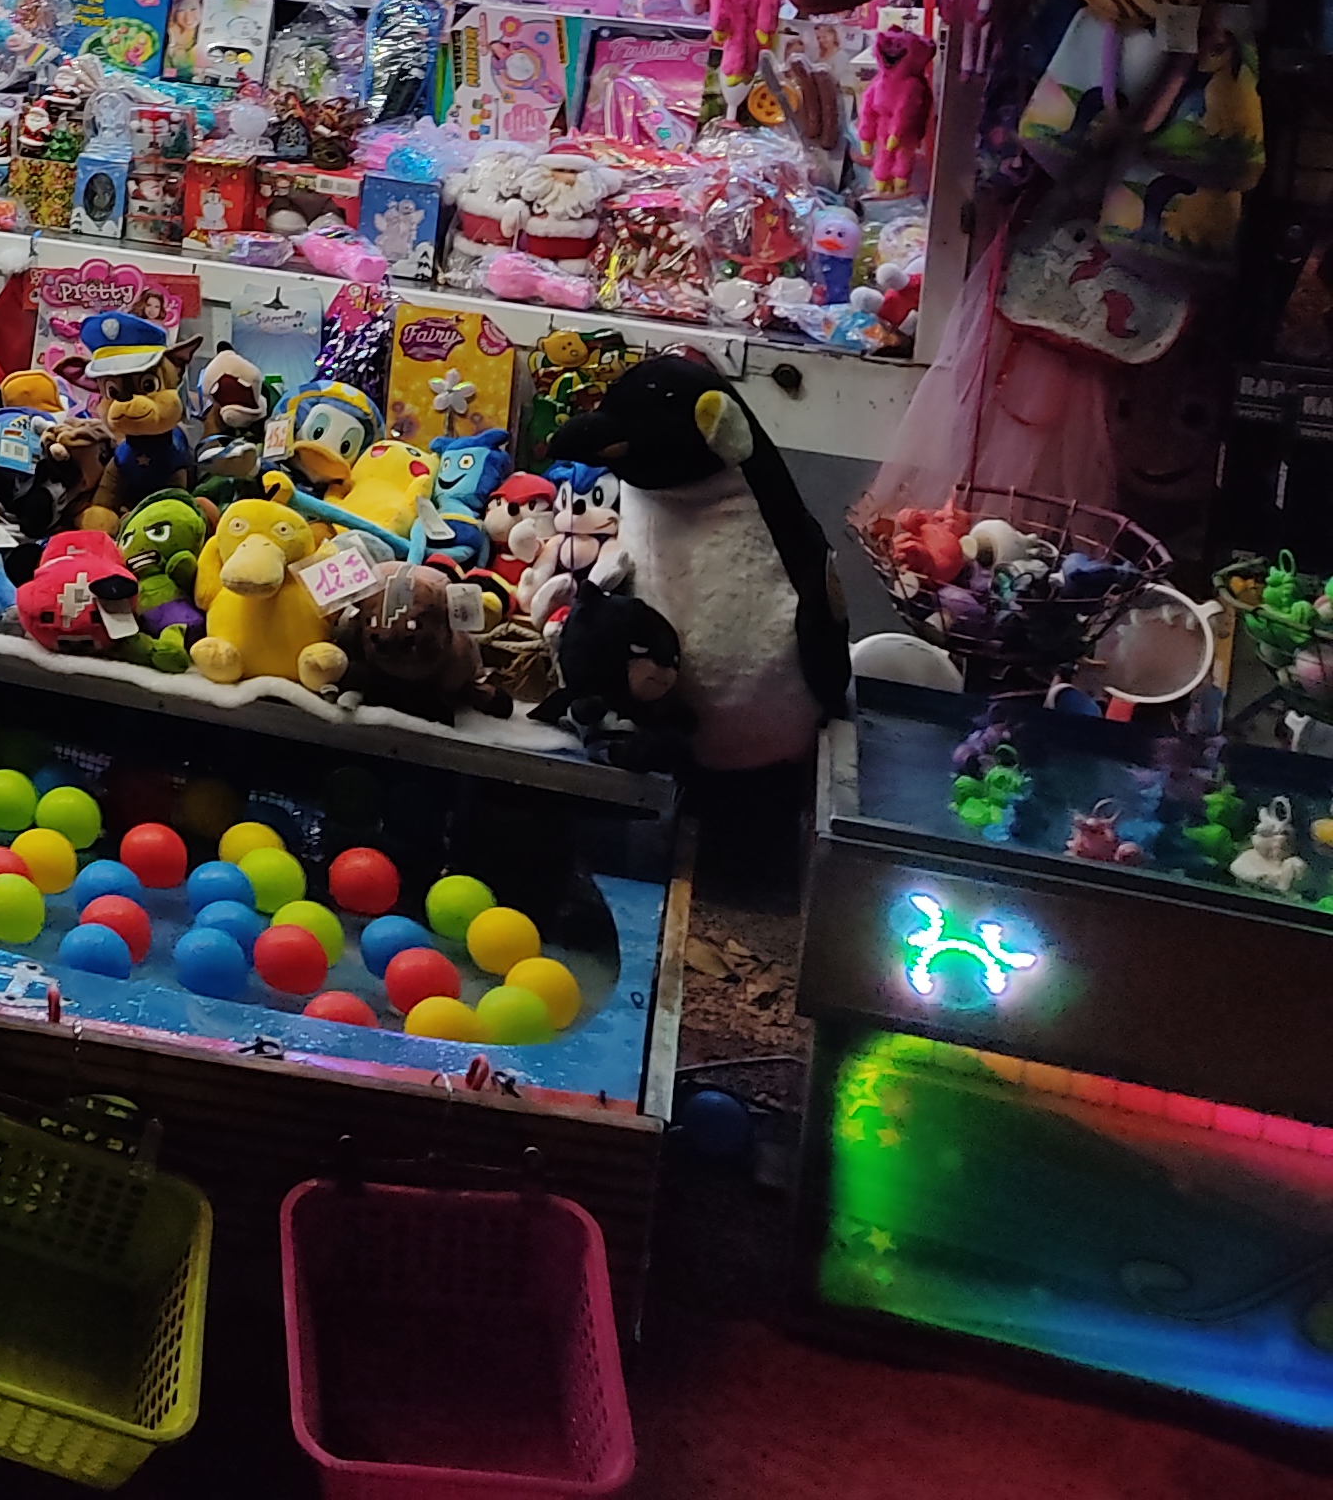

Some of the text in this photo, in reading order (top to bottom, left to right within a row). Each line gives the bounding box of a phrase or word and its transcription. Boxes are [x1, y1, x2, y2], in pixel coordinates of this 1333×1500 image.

[464, 26, 480, 88] MIRROR
[60, 282, 134, 305] Pretty
[402, 324, 460, 352] Fairy
[1301, 394, 1333, 418] RA
